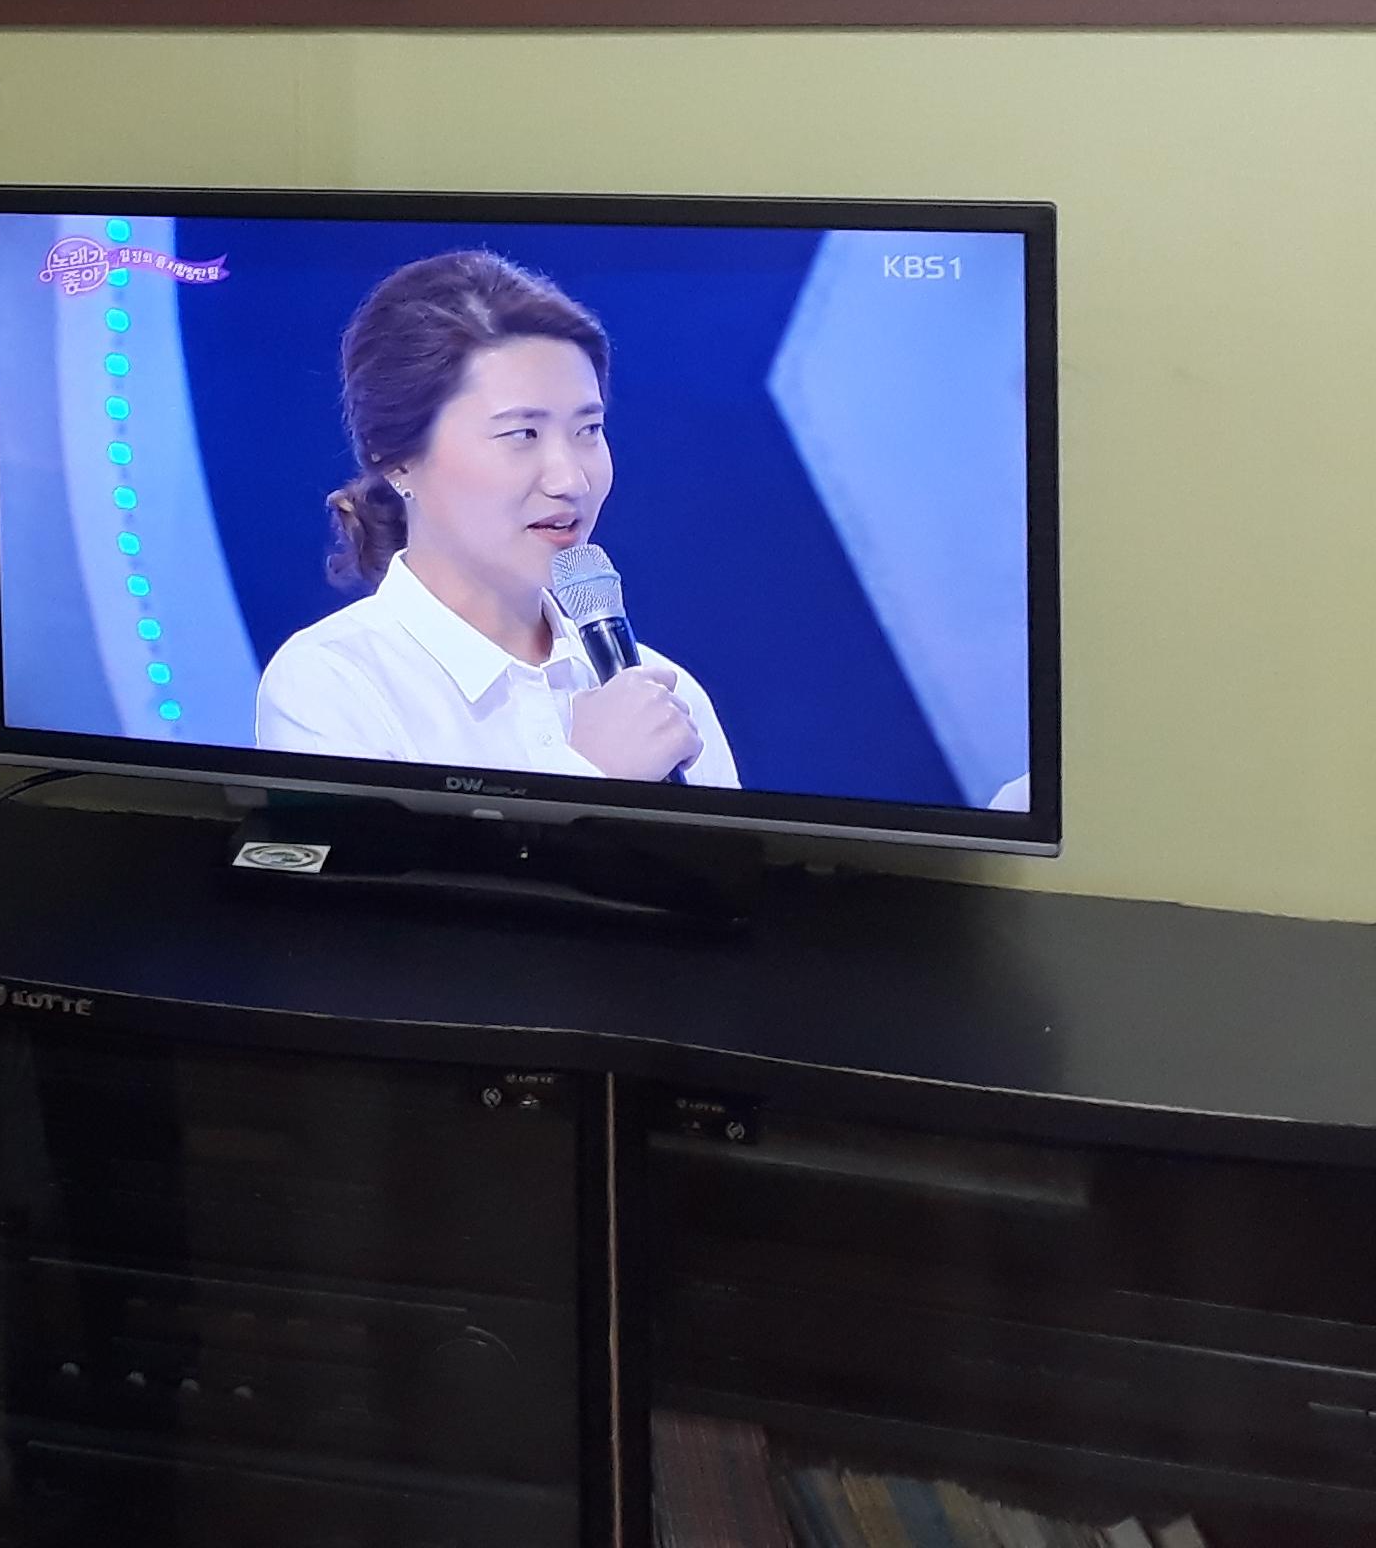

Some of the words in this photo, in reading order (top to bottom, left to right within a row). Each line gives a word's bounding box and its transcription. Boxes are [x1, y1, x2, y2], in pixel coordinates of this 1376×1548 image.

[52, 245, 108, 268] 노래가
[883, 254, 962, 280] KBS1
[61, 268, 101, 295] 좋아
[10, 990, 94, 1017] LOTTE
